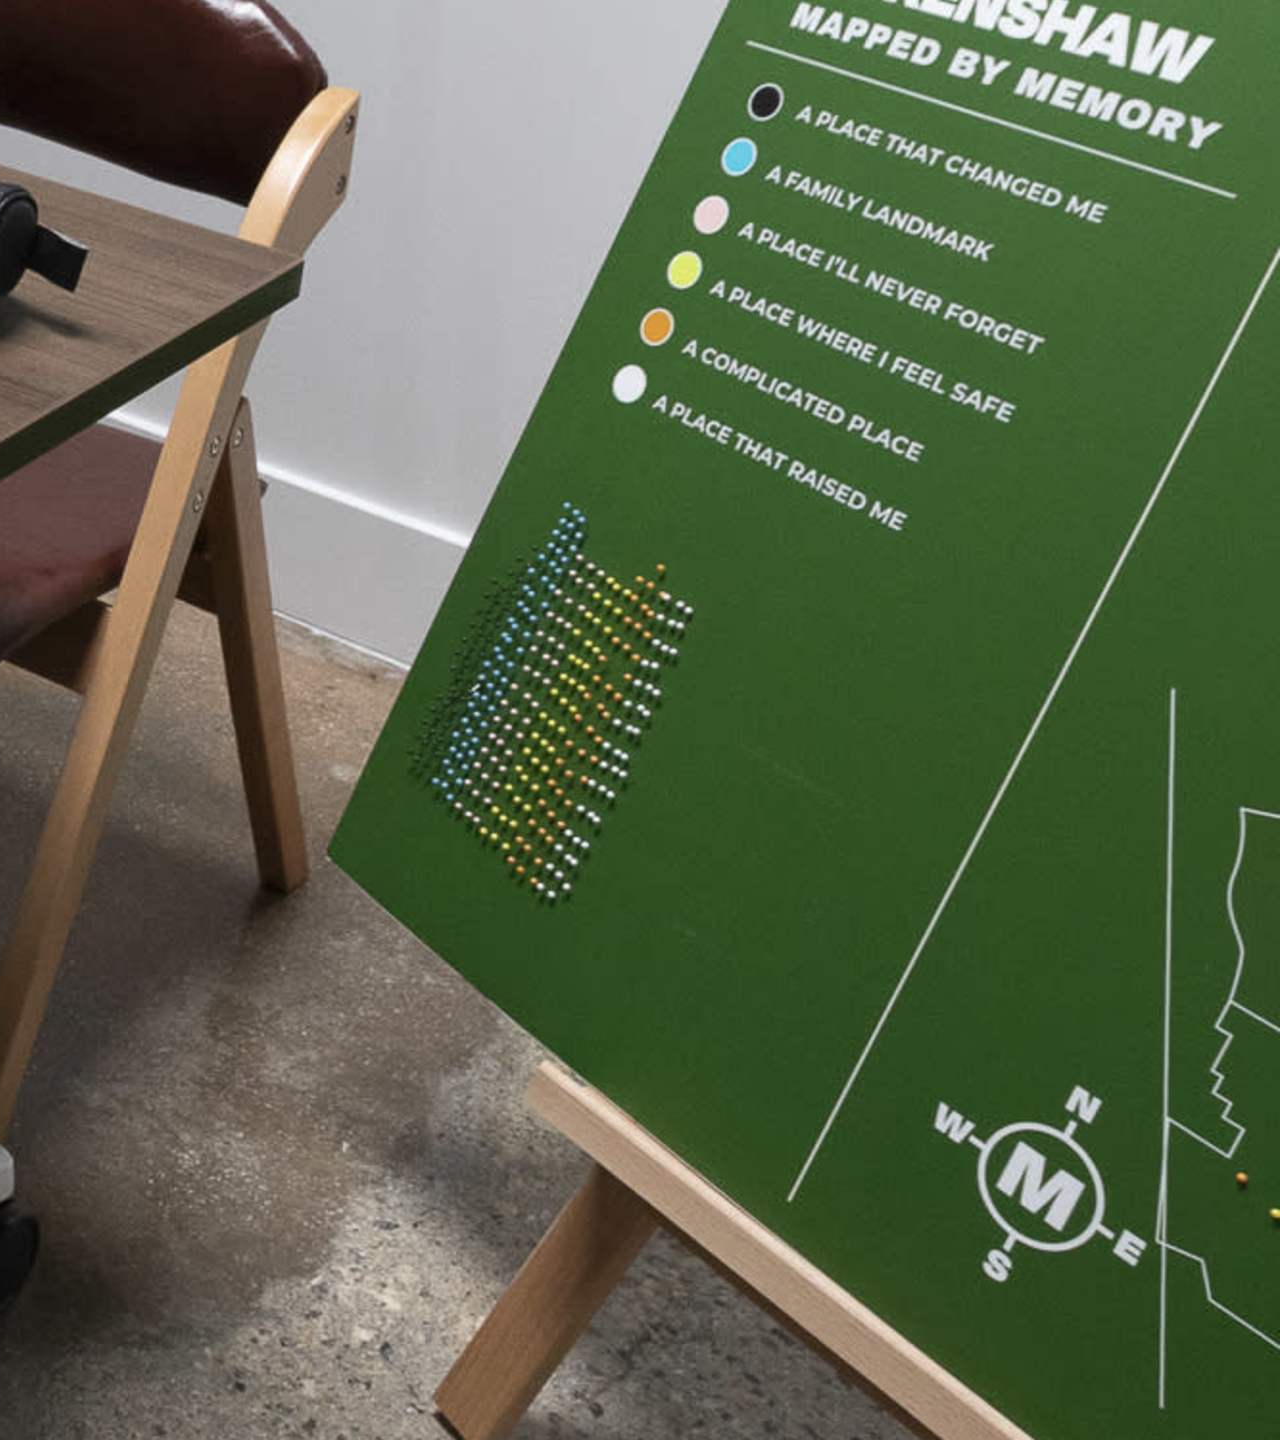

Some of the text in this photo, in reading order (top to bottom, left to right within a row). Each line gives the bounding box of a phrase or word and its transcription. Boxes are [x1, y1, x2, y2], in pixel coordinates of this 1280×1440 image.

[789, 1, 1221, 149] MAPPED BY MEMORY
[765, 165, 994, 260] A FAMILY LANDMARK
[795, 105, 1107, 222] A PLACE THAT CHANGED ME
[738, 222, 1045, 353] A PLACE I'LL NEVER FORGET
[682, 340, 924, 462] A COMPLICATED PLACE
[709, 280, 1015, 422] A PLACE WHERE I FEEL SAFE
[652, 395, 907, 530] A PLACE THAT RAISED ME
[934, 1101, 974, 1143] W
[1064, 1085, 1102, 1123] N
[996, 1141, 1085, 1231] M
[982, 1248, 1012, 1282] S
[1112, 1229, 1146, 1266] E
